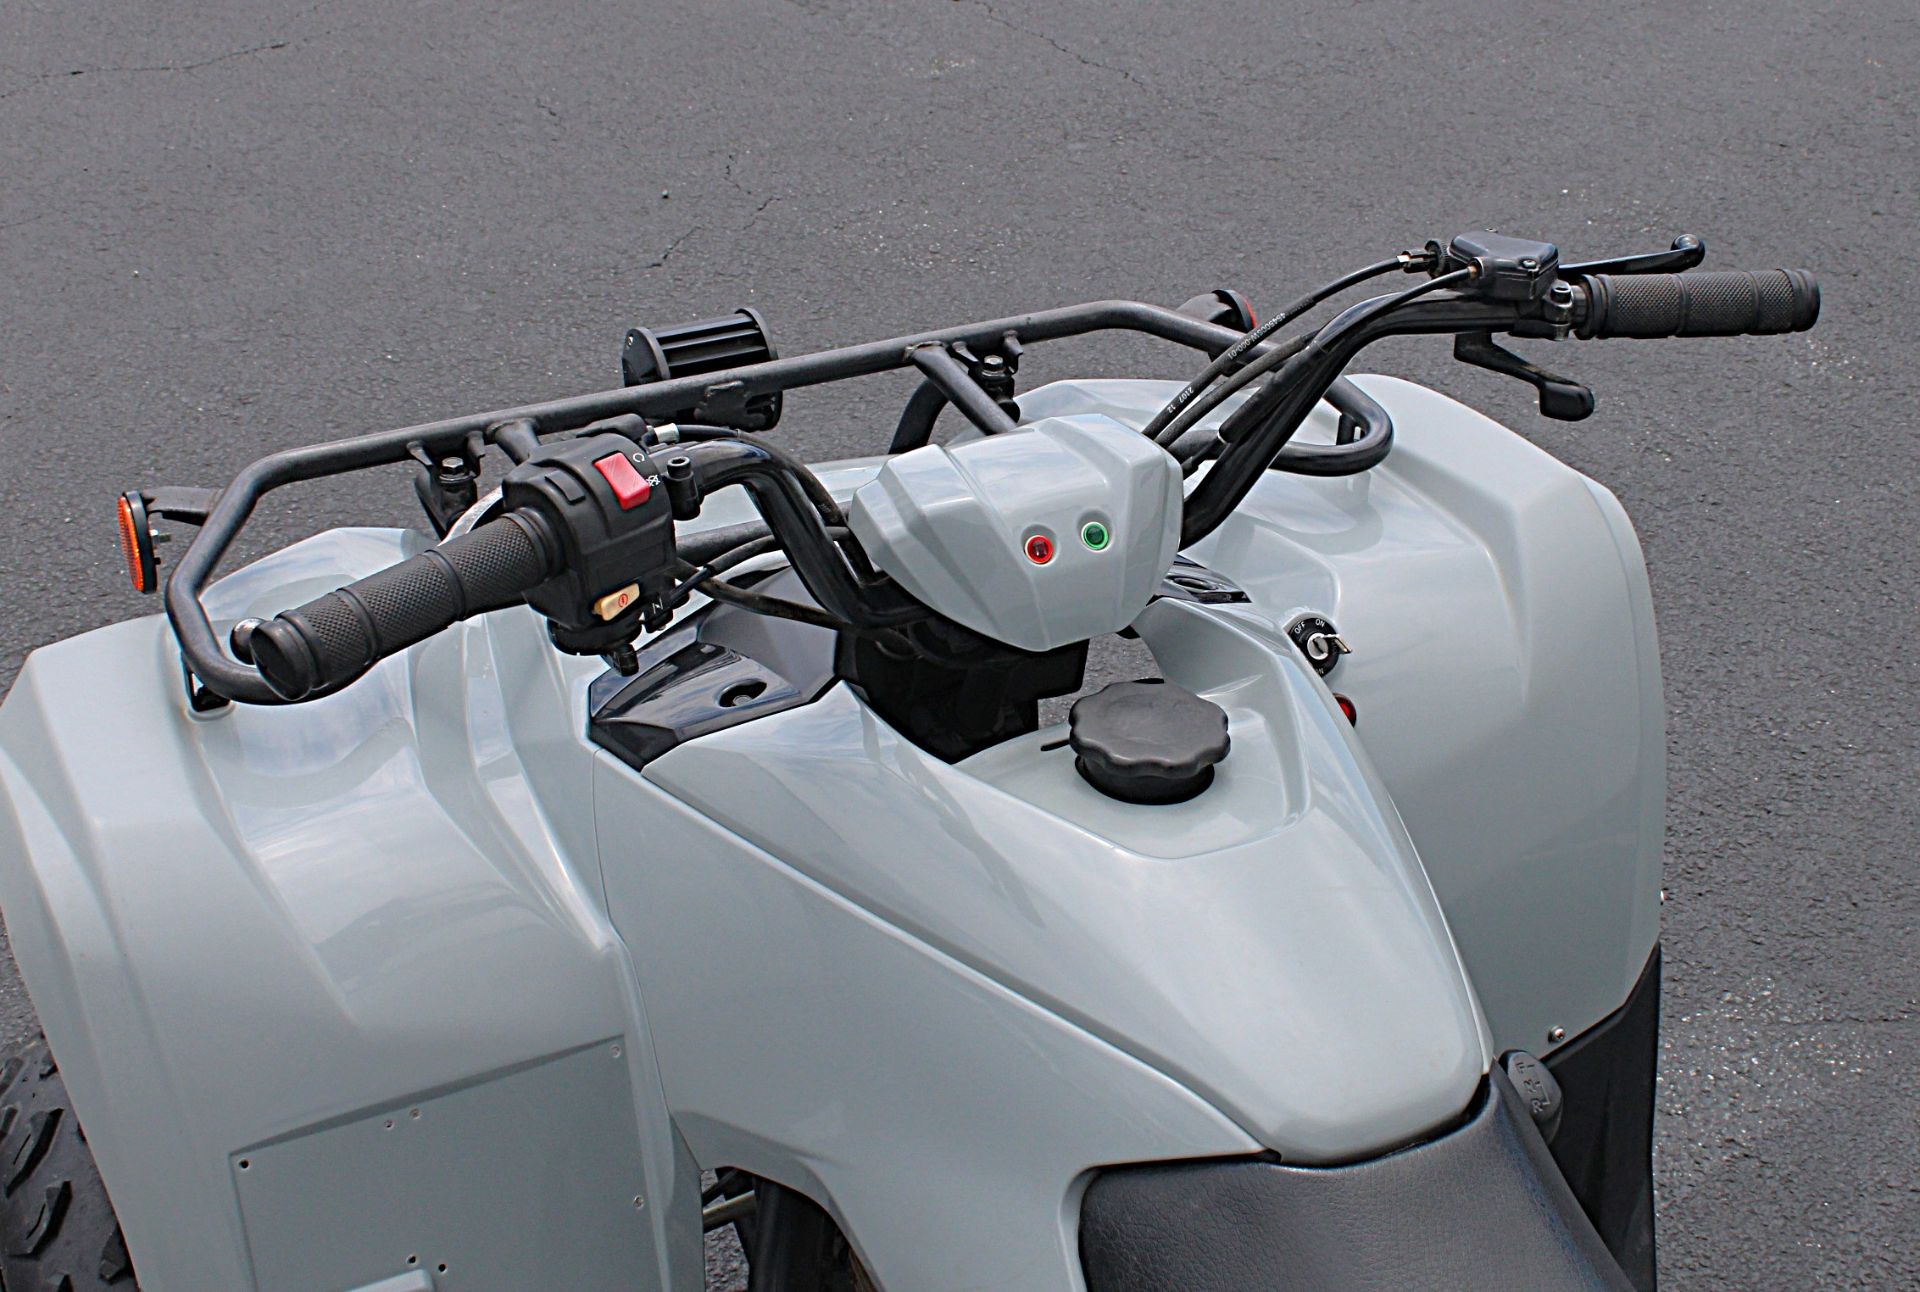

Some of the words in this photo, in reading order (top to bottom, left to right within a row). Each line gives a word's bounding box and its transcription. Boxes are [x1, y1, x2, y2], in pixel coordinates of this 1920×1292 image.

[1178, 386, 1194, 403] 2107
[1166, 404, 1177, 414] 12
[1294, 620, 1306, 634] OFF
[1315, 618, 1326, 628] ON
